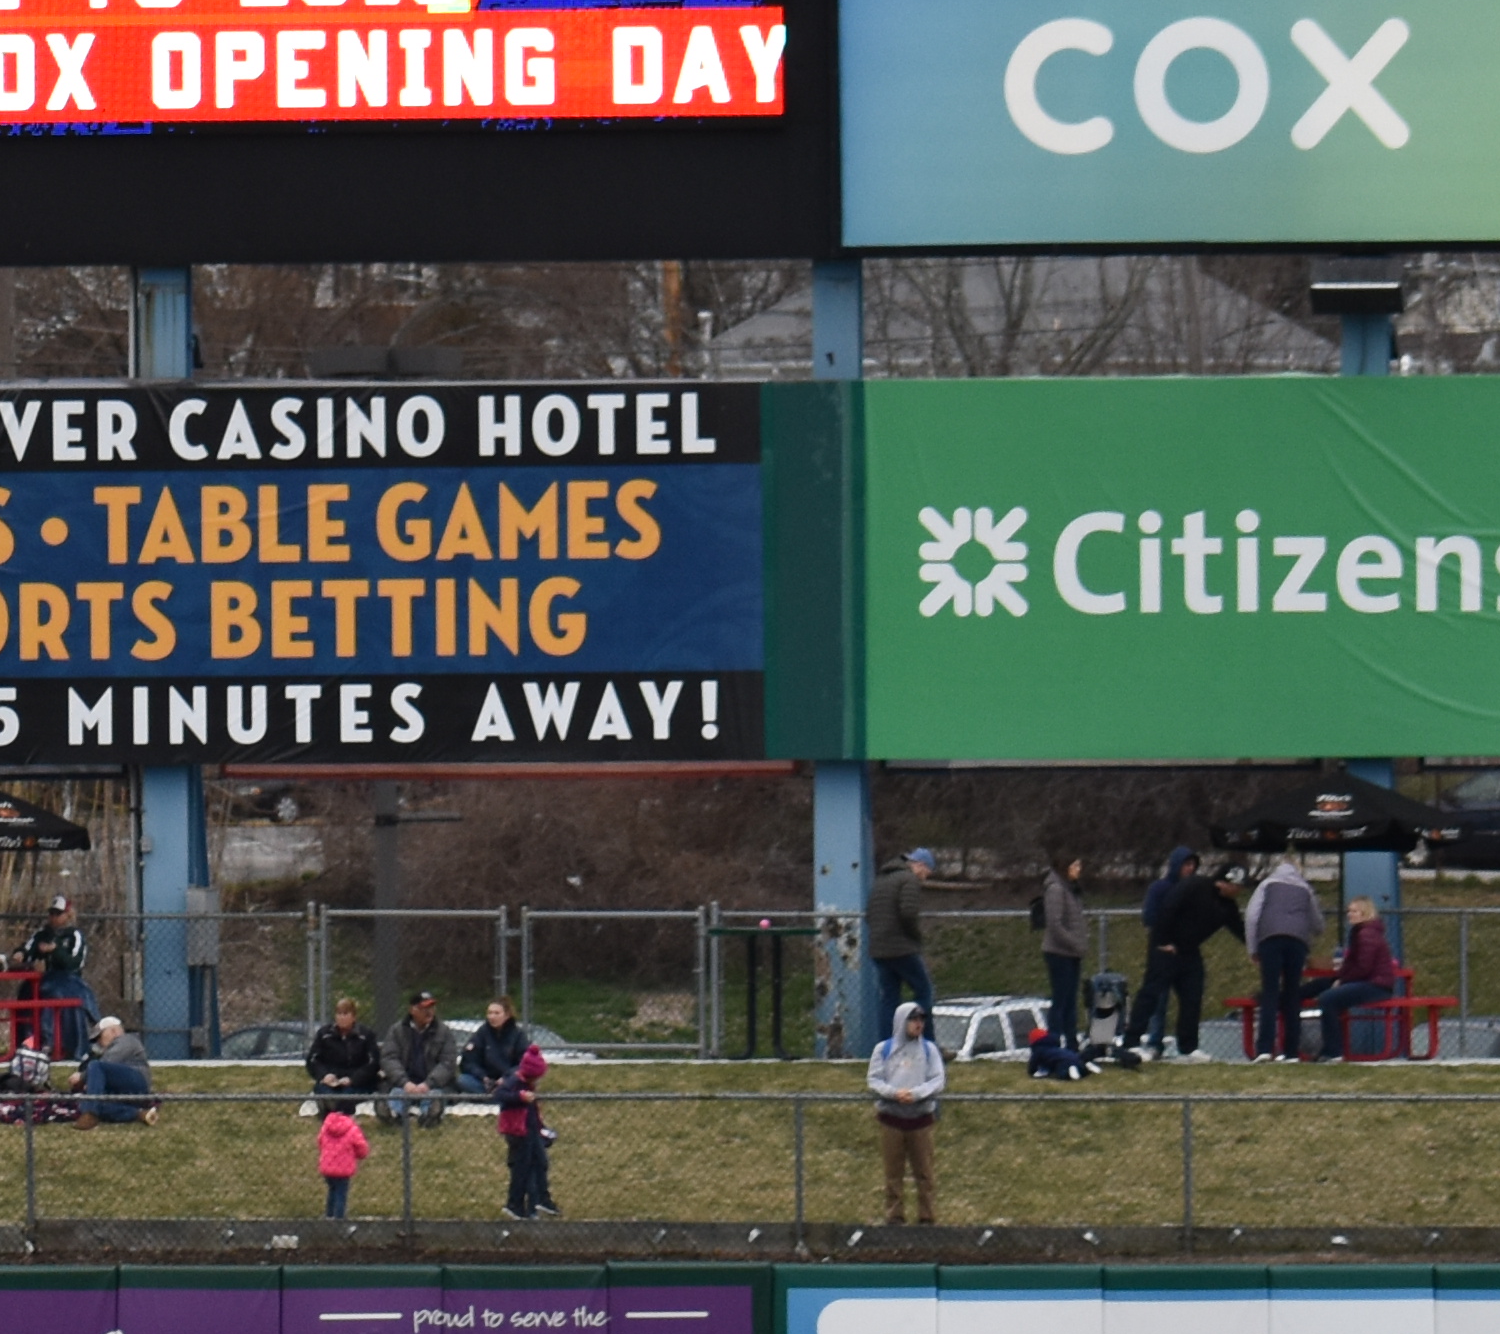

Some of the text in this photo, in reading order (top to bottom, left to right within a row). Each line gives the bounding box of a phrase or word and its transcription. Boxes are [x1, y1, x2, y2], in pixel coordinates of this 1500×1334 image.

[149, 27, 557, 112] OPENING
[612, 24, 787, 106] DAY
[1004, 16, 1411, 155] COX
[168, 394, 446, 459] CASINO
[477, 391, 716, 456] HOTEL
[93, 483, 351, 566] TABLE
[376, 479, 660, 563] GAMES
[210, 577, 588, 658] BETTING
[66, 683, 426, 745] MINUTES
[471, 680, 723, 742] AWAY!
[413, 1305, 612, 1333] proud to serve the
